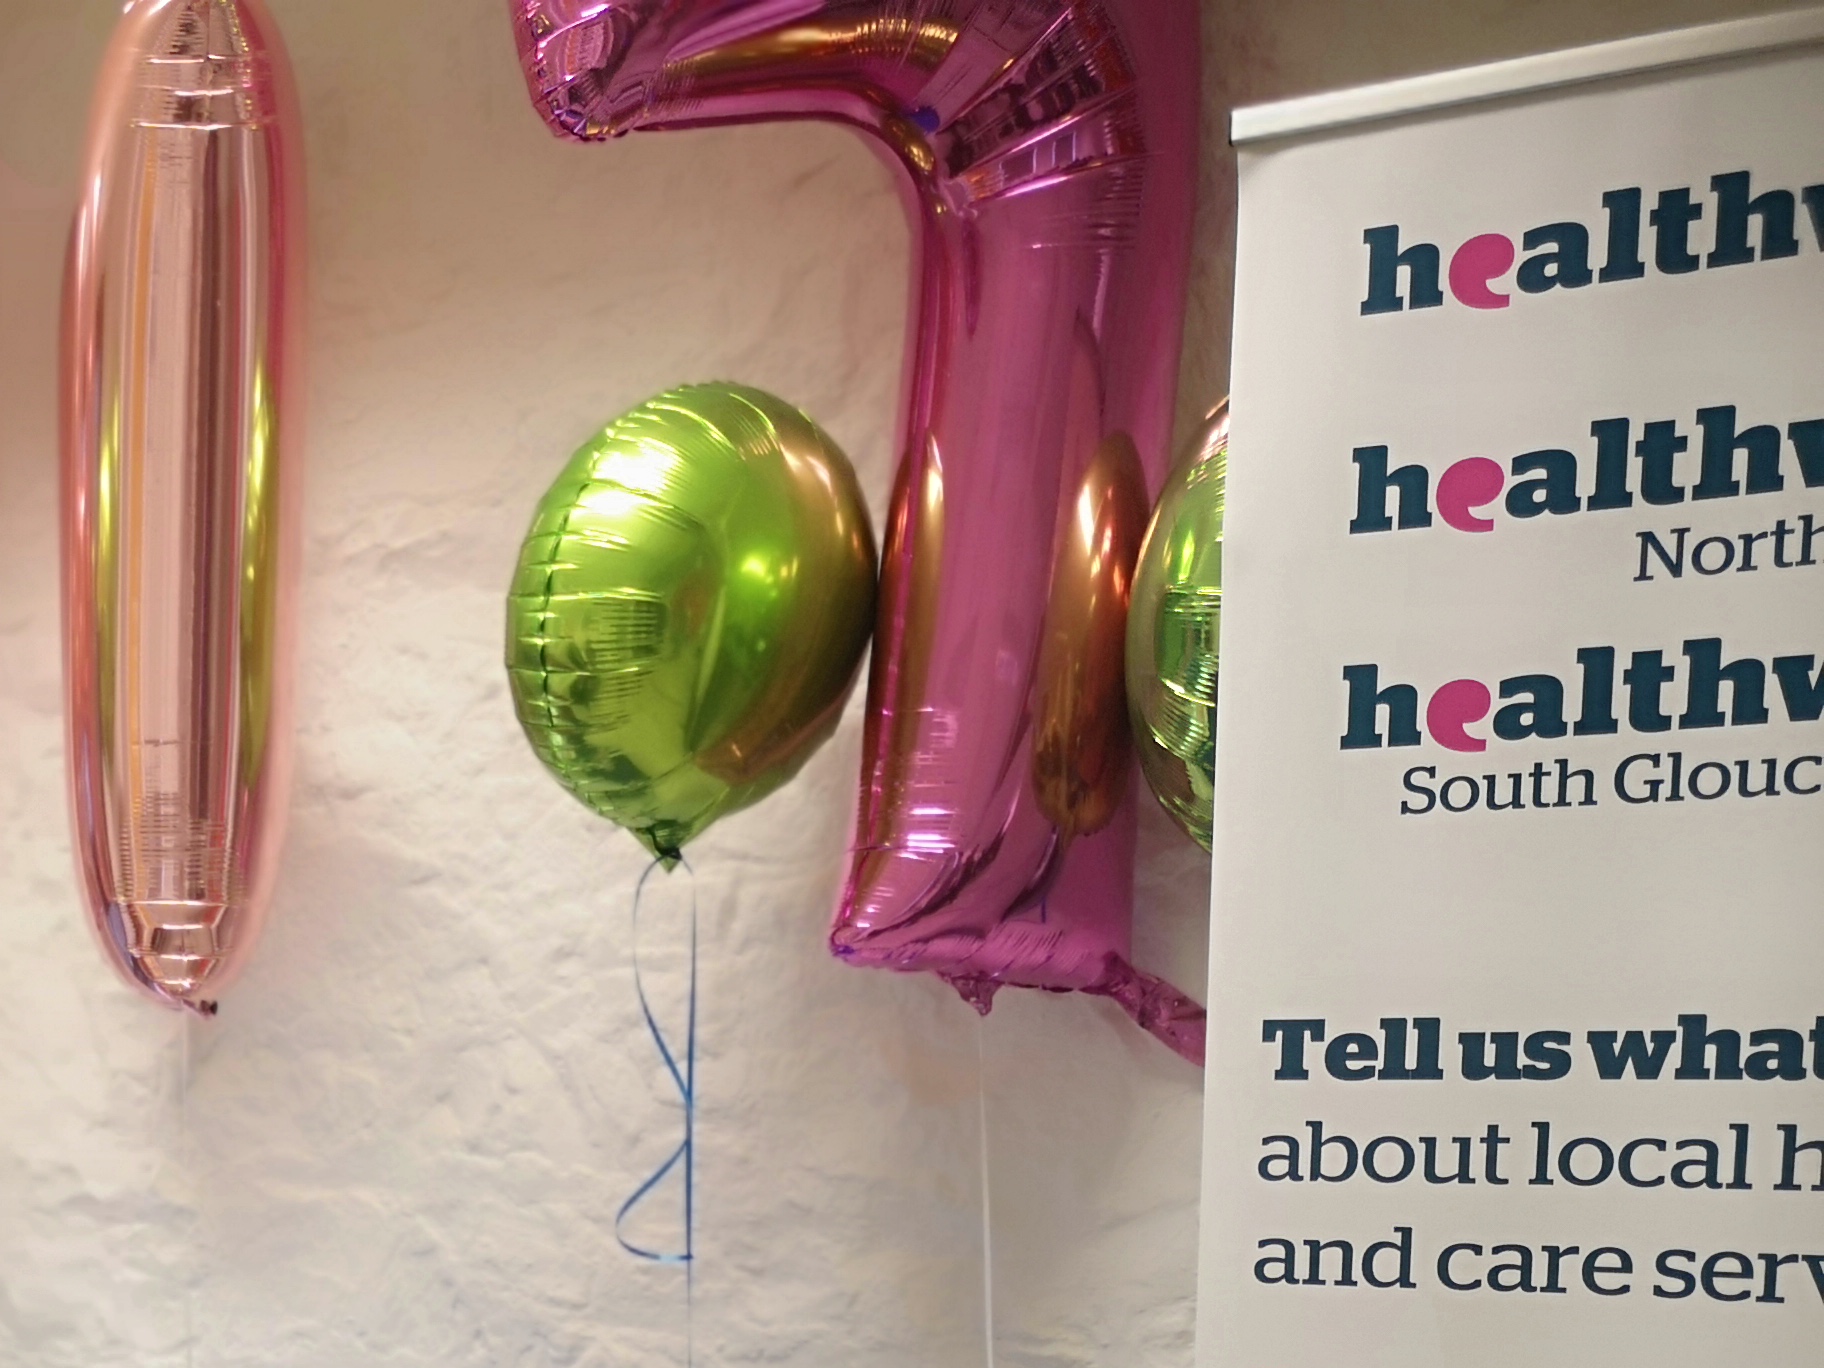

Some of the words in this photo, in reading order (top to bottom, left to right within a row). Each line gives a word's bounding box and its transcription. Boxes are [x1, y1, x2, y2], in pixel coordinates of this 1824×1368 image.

[1360, 170, 1824, 316] health
[1399, 758, 1598, 817] South
[1613, 751, 1824, 804] Glouc
[1262, 1017, 1443, 1081] Tell
[1458, 1031, 1572, 1081] us
[1257, 1120, 1510, 1184] about
[1529, 1121, 1752, 1190] local
[1254, 1226, 1417, 1290] and
[1436, 1242, 1633, 1297] care
